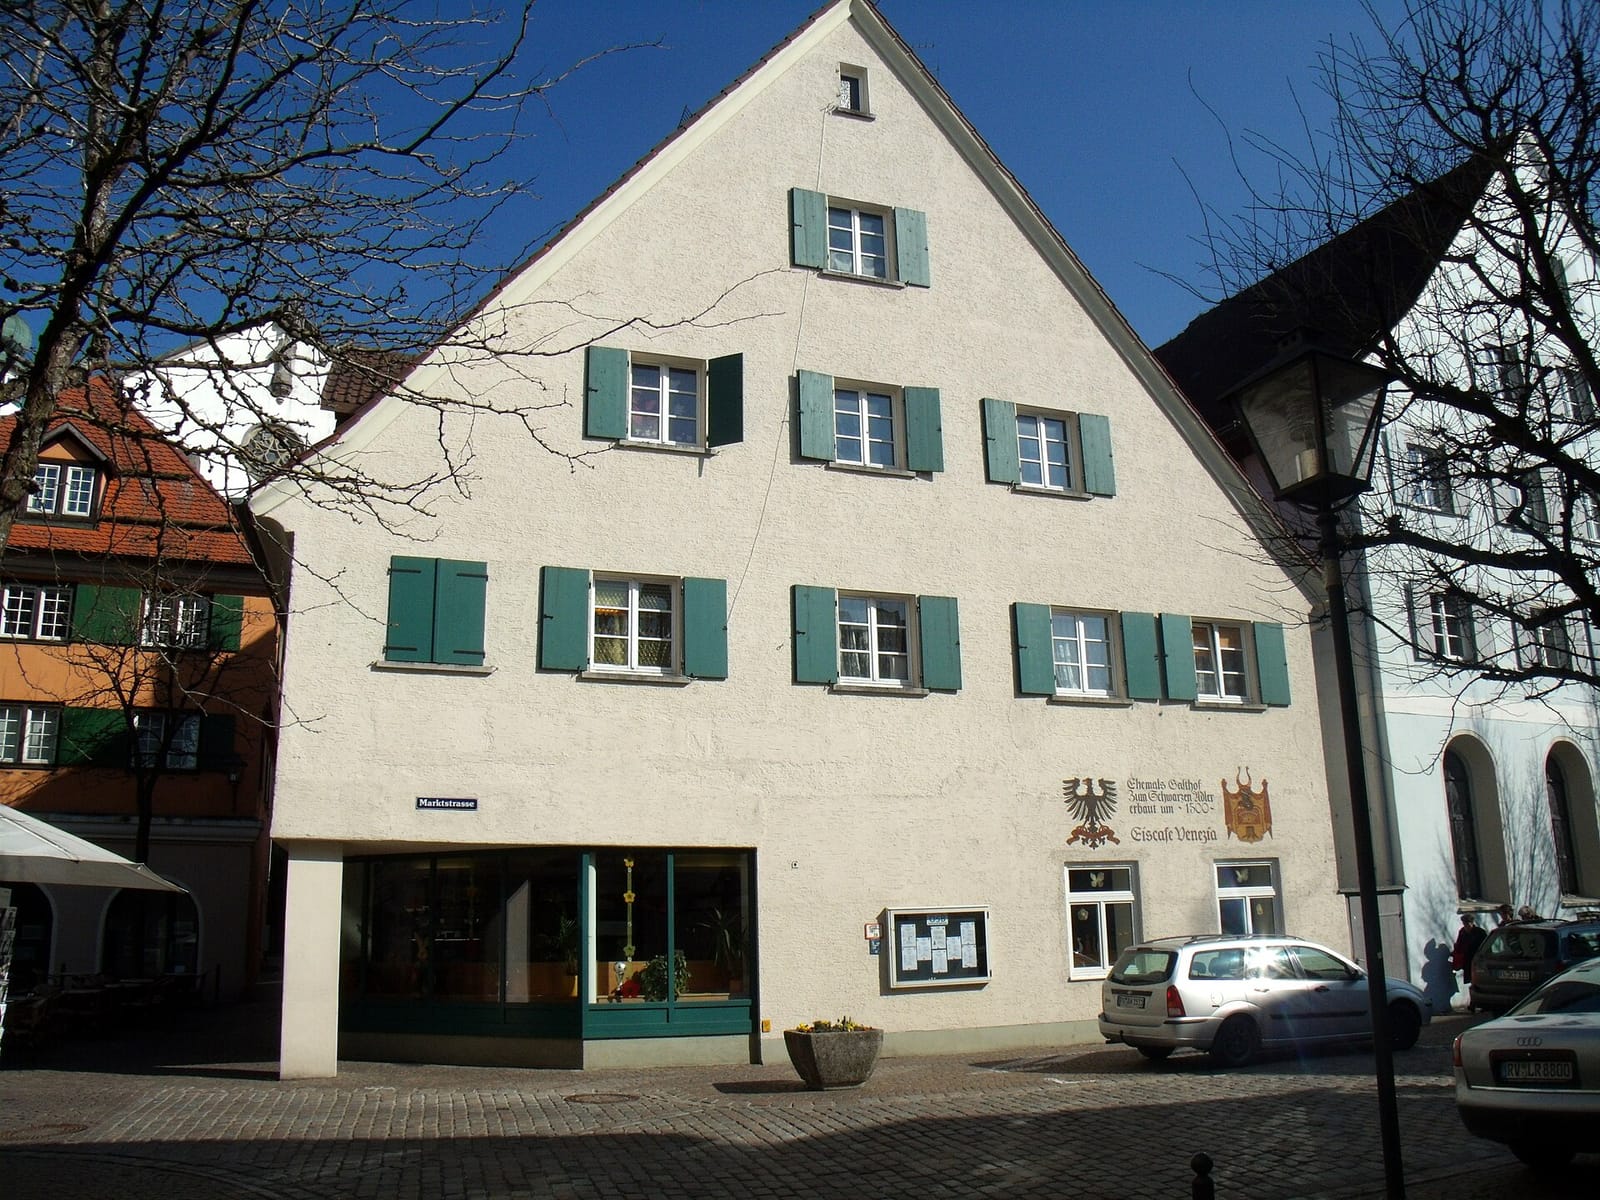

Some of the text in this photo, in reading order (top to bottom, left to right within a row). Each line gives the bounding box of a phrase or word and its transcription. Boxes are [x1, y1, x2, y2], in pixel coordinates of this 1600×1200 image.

[1127, 778, 1166, 790] Ehemals
[1128, 790, 1214, 803] Zum Schwarzen Adler
[419, 798, 475, 808] Marktstrasse
[1129, 803, 1156, 814] erbaut
[1160, 804, 1174, 814] um
[1174, 826, 1218, 844] Venezia
